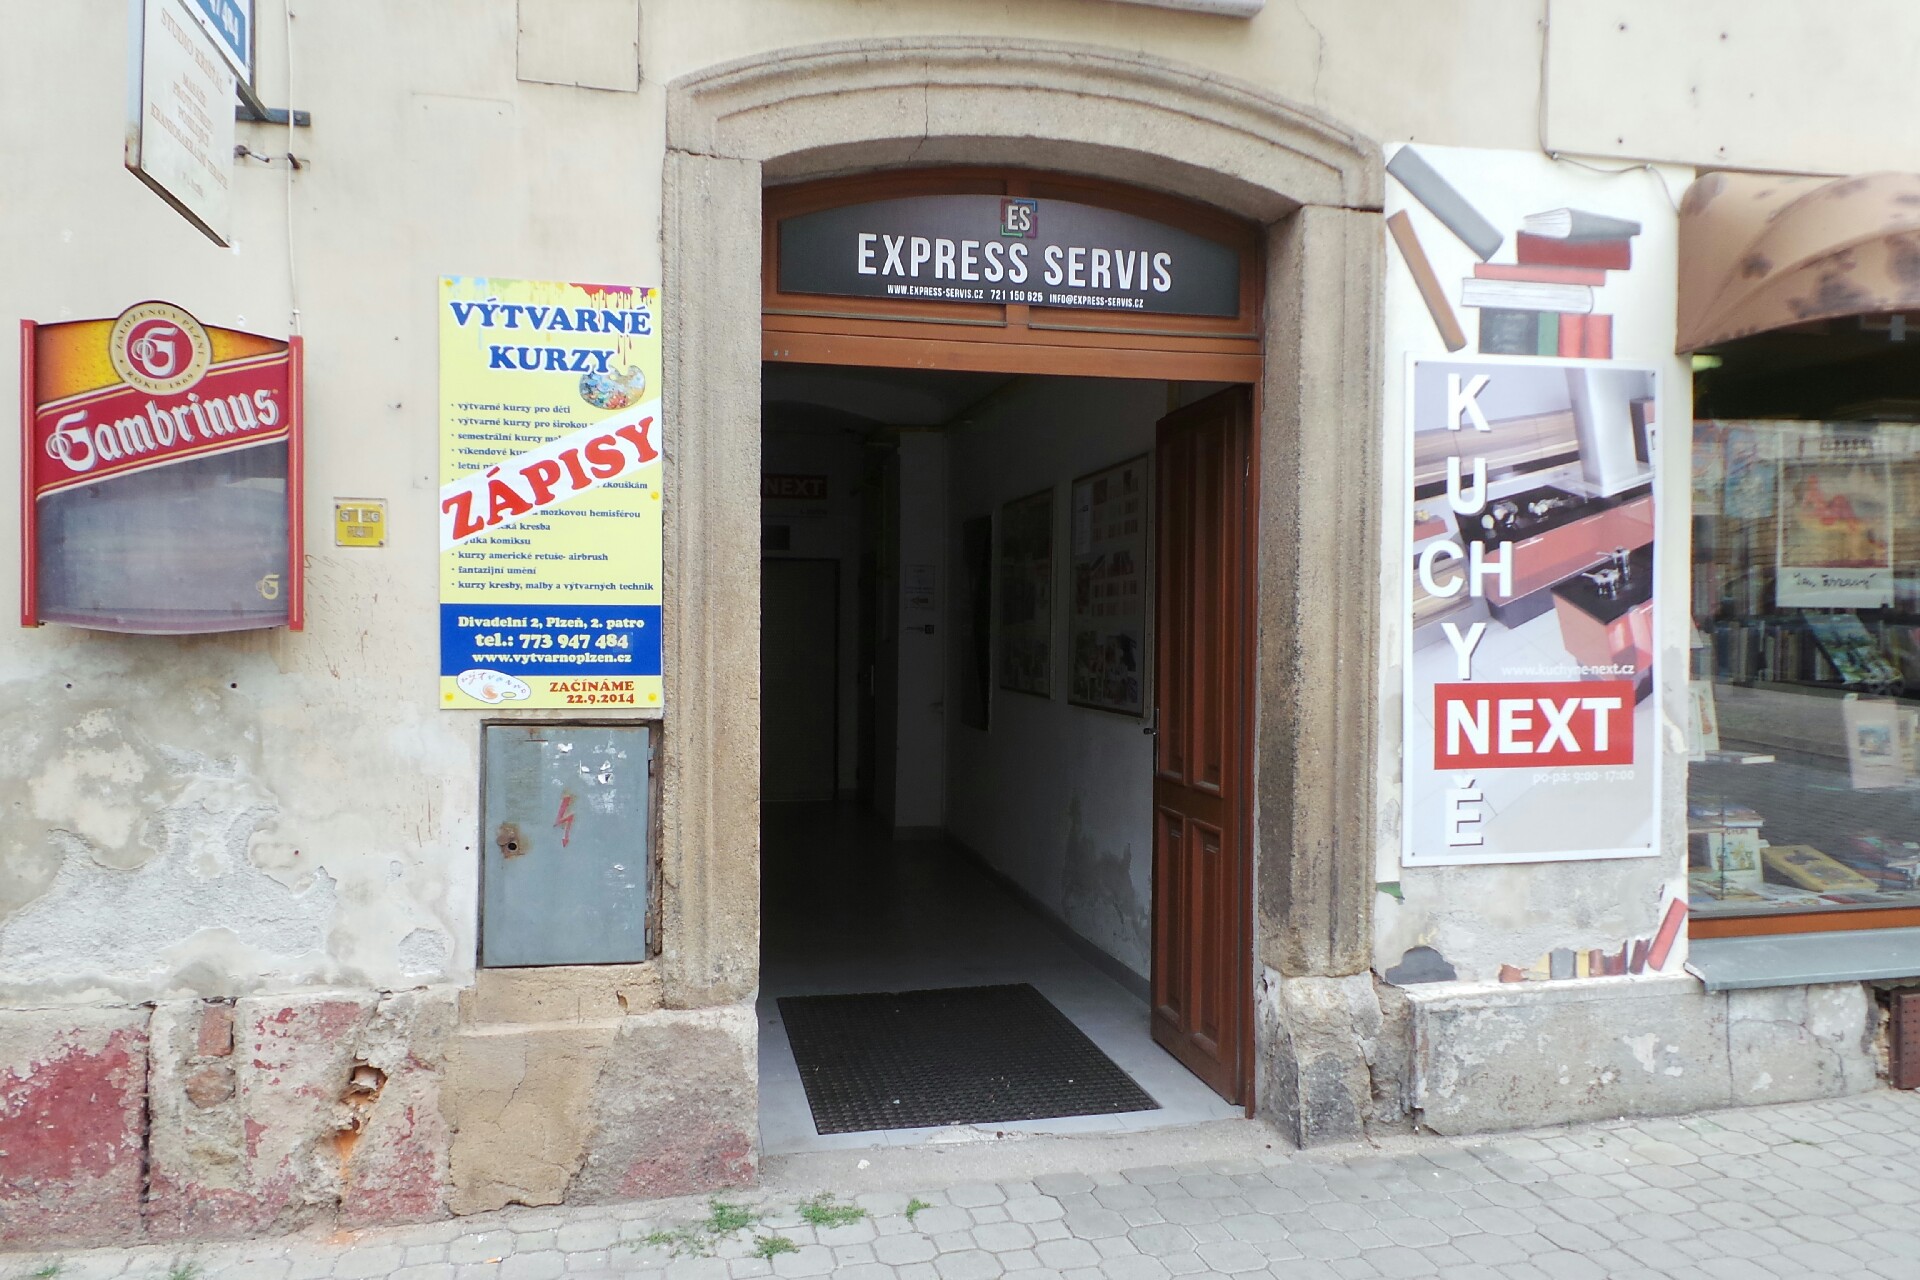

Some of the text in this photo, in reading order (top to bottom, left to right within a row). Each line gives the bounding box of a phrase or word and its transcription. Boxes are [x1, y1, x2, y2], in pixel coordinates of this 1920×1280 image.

[1007, 205, 1032, 232] ES
[857, 232, 1173, 293] EXPRESS SERVIS
[887, 284, 984, 300] WWW.EXPRESS-SERVIS.CZ
[990, 289, 1006, 300] 721
[1049, 293, 1144, 309] INFO@EXPRESS-SERVIS.CZ
[450, 297, 651, 335] VÝTVARNÉ
[489, 345, 615, 373] KURZY
[169, 373, 194, 389] 1869
[458, 402, 571, 414] výtvarné kurzy pro děti
[46, 388, 280, 472] Gambrinus
[503, 418, 531, 428] kurzy
[534, 420, 550, 429] pro
[458, 432, 512, 441] semestrální
[514, 433, 542, 443] kurzy
[458, 447, 507, 456] víkendové
[458, 461, 480, 470] letní
[441, 416, 659, 540] ZÁPISY
[764, 478, 823, 496] NEXT
[589, 509, 640, 518] hemisférou
[519, 522, 550, 531] kresba
[490, 536, 530, 545] komiksu
[458, 551, 486, 561] kurzy
[489, 551, 532, 560] americké
[568, 553, 609, 562] airbrush
[458, 566, 536, 576] fantazijní umění
[458, 580, 486, 591] kurzy
[525, 581, 553, 591] malby
[619, 582, 654, 591] technik
[458, 616, 645, 630] Divadelní 2, Plzeň, 2. patro
[475, 633, 629, 649] tel.: 773 947 484
[472, 652, 632, 665] www.vytvarnoplzen.cz
[549, 679, 635, 692] ZAČÍNÁME
[566, 694, 635, 704] 22.9.2014
[1447, 697, 1622, 755] NEXT
[1605, 770, 1635, 783] 17:00
